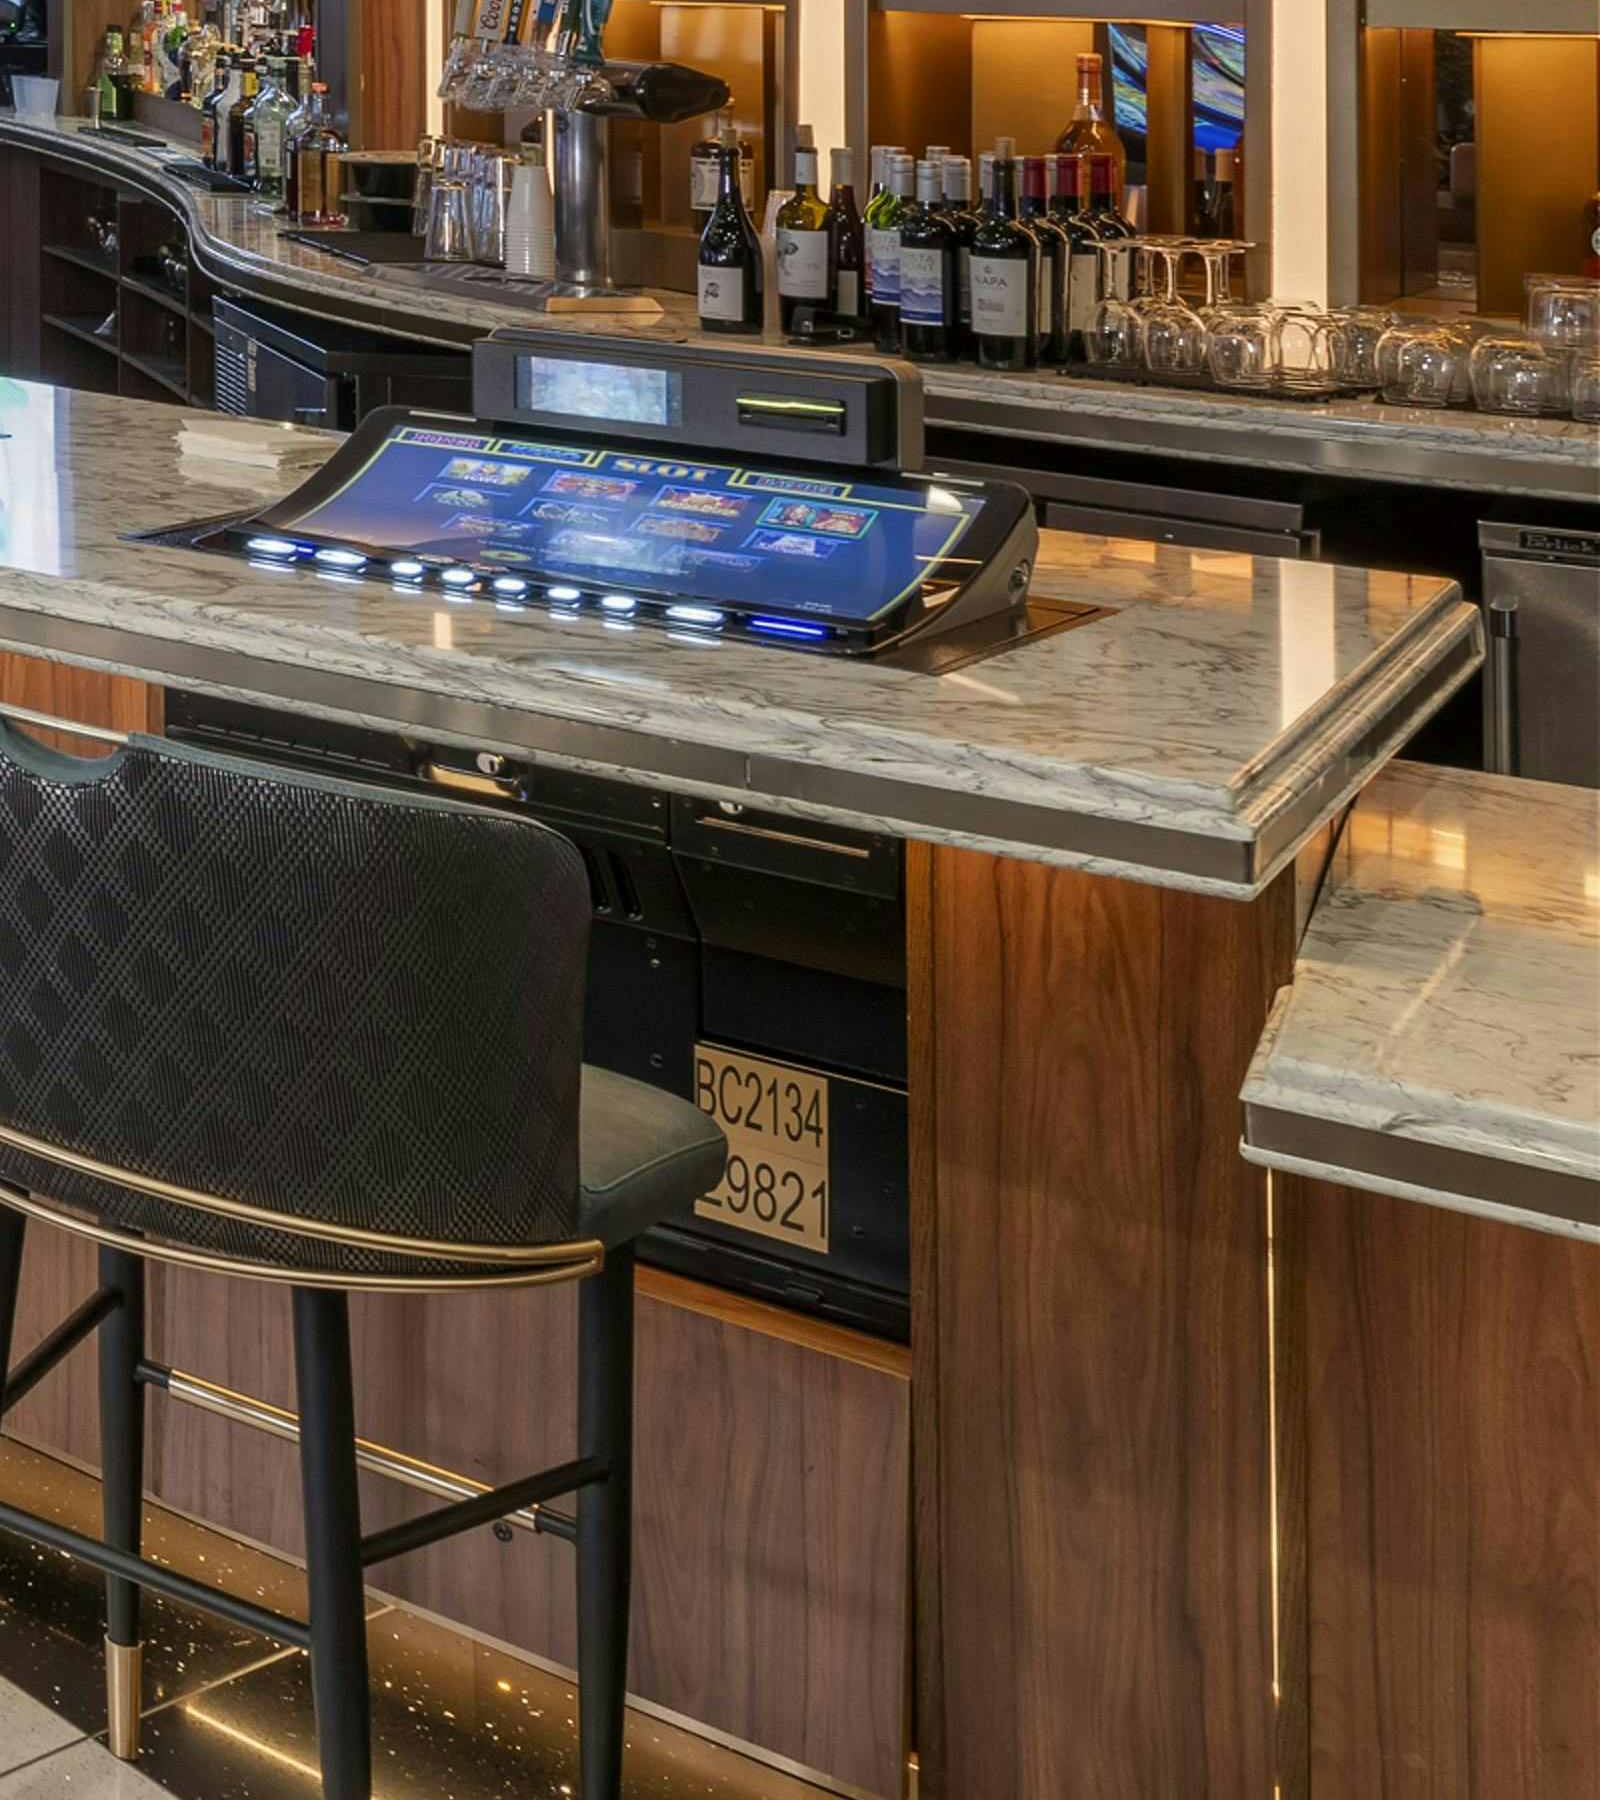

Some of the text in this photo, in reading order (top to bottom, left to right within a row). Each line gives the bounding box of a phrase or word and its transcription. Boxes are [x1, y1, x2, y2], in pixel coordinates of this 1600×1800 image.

[612, 458, 717, 482] SLOT
[1526, 533, 1596, 555] Perlick
[695, 1057, 824, 1149] BC2134
[703, 1154, 826, 1240] 9821
